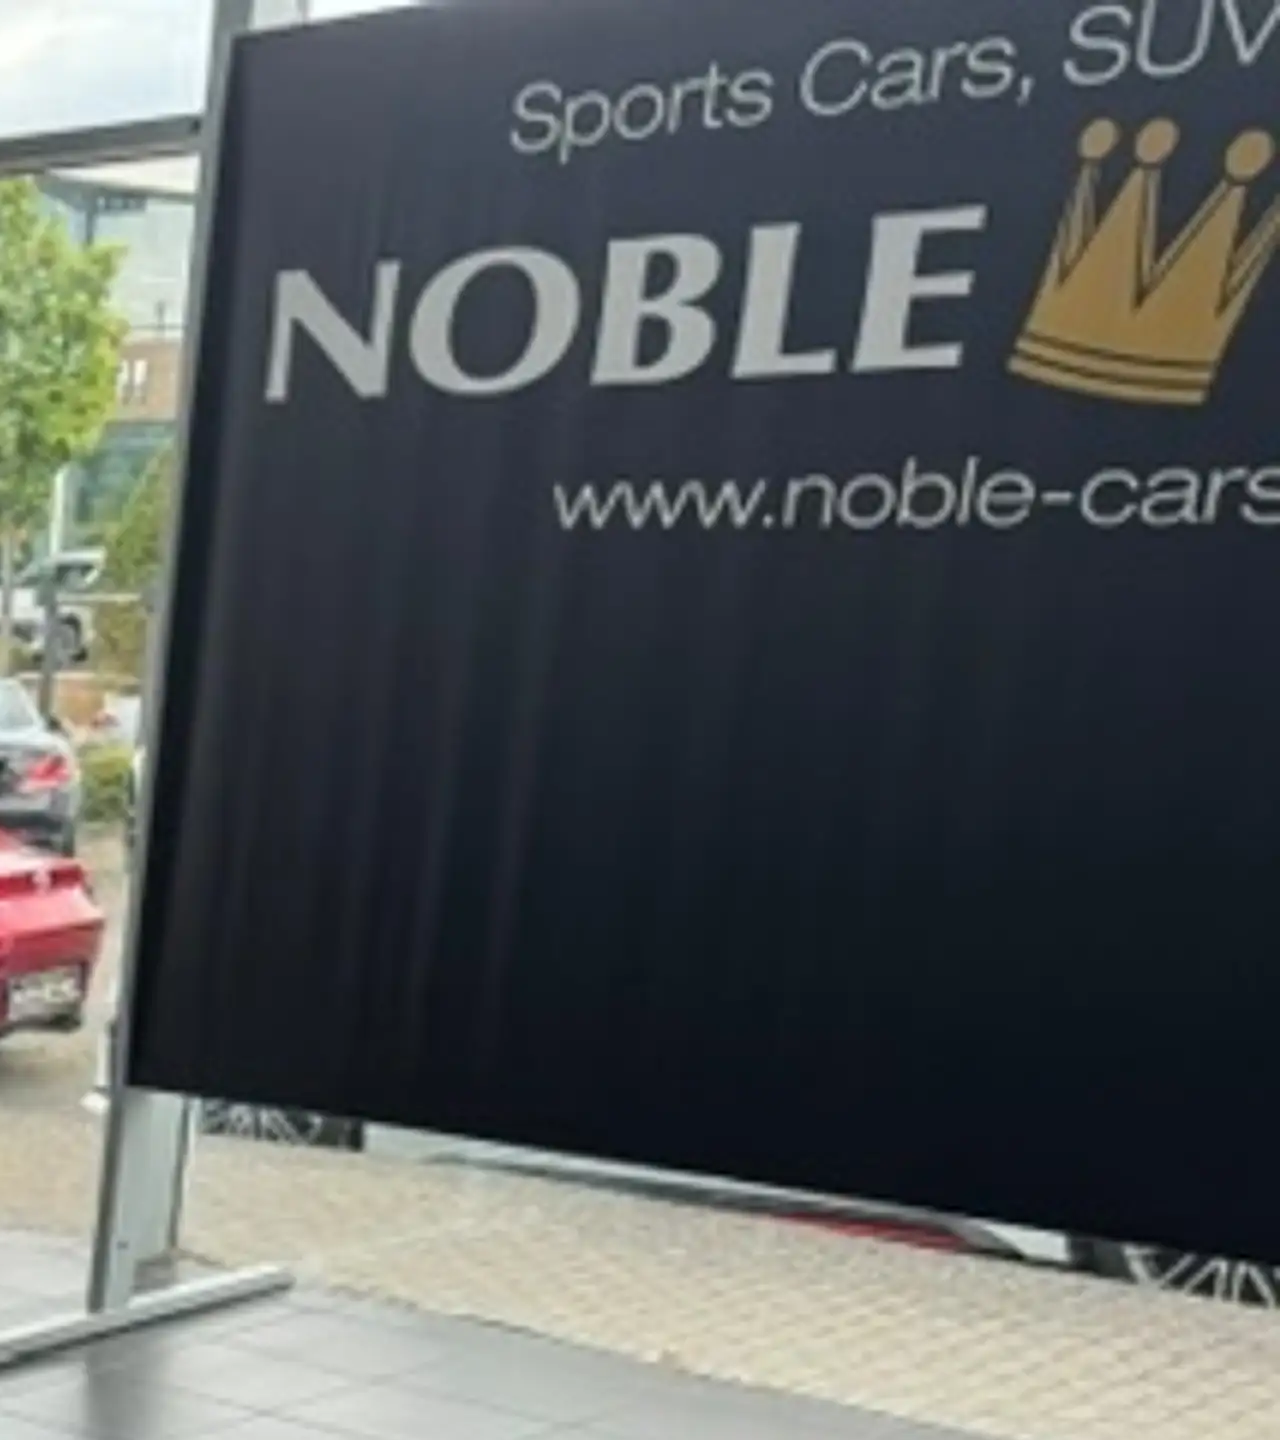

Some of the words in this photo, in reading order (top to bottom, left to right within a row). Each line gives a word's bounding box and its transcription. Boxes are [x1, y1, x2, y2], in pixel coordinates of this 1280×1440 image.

[509, 61, 775, 165] Sports
[800, 35, 1036, 116] Cars,
[263, 203, 989, 403] NOBLE
[551, 453, 1280, 531] www.noble-cars
